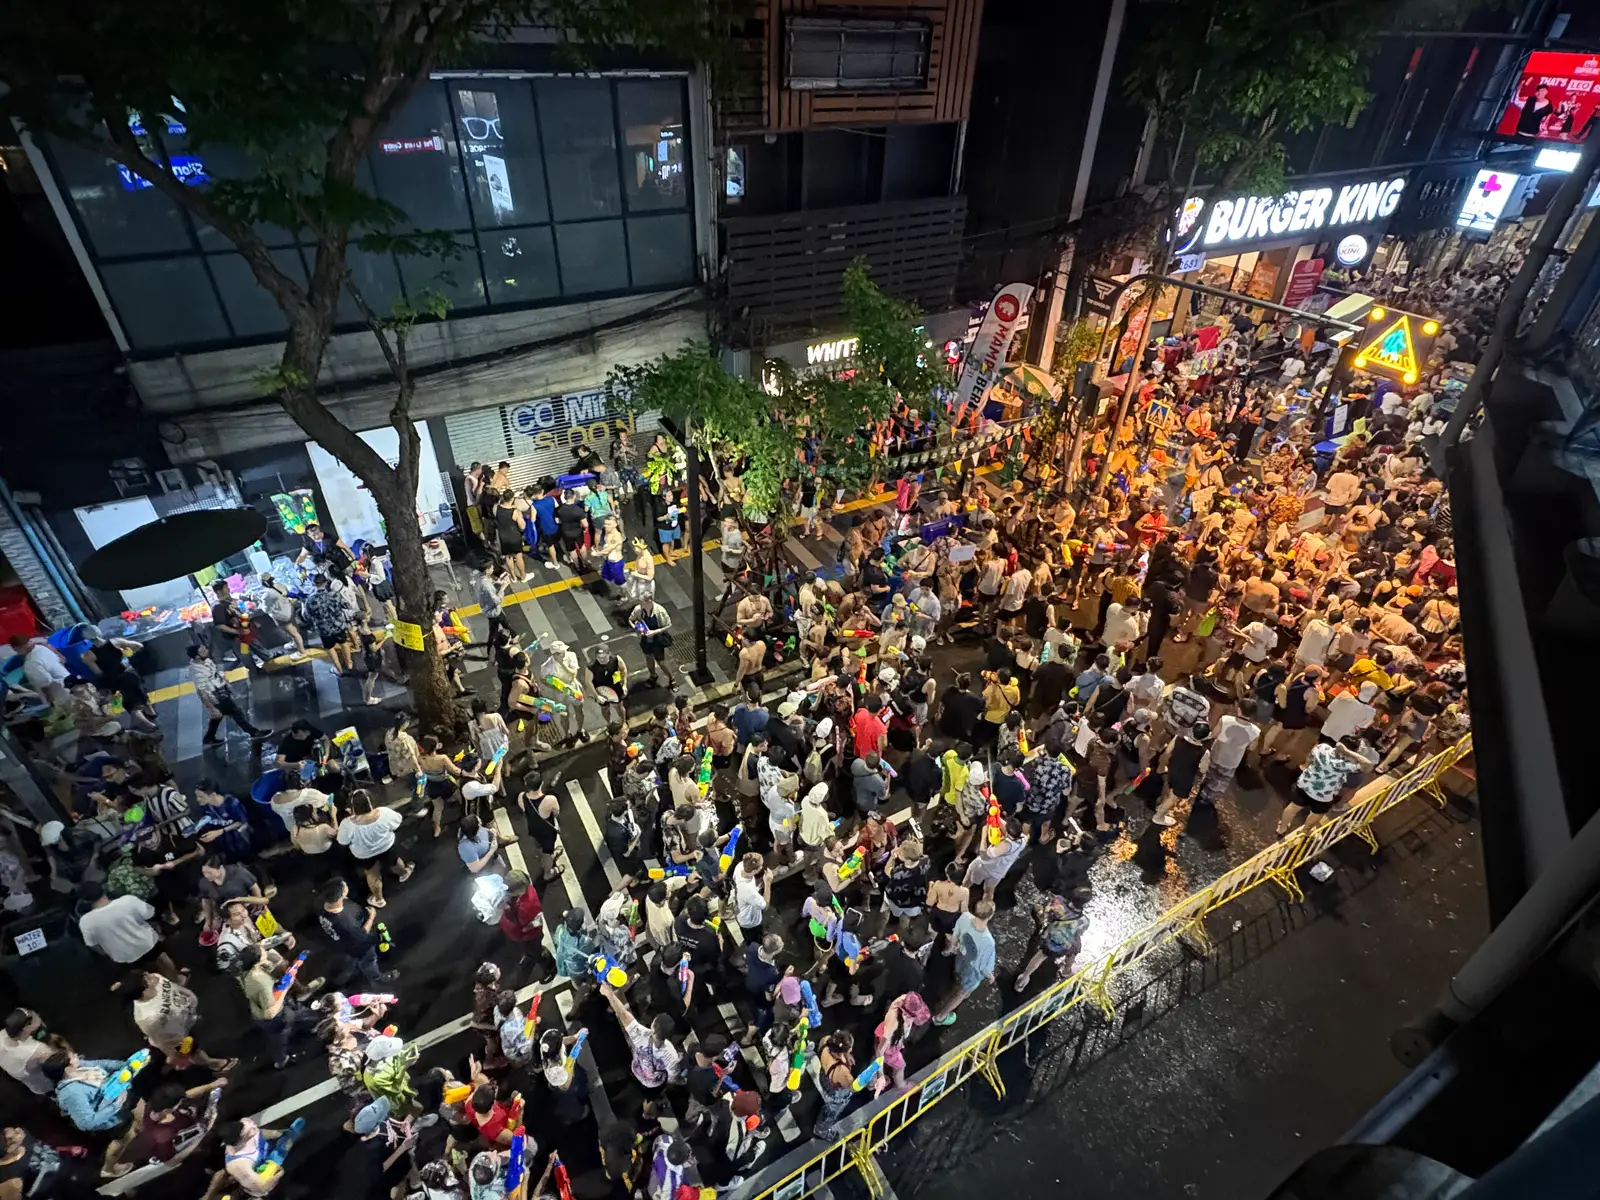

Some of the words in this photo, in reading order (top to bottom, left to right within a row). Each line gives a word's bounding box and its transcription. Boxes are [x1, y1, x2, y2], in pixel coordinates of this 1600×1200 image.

[1571, 81, 1590, 90] LEO
[1204, 188, 1332, 244] BURGER
[1331, 178, 1405, 225] KING
[16, 931, 40, 944] WATER
